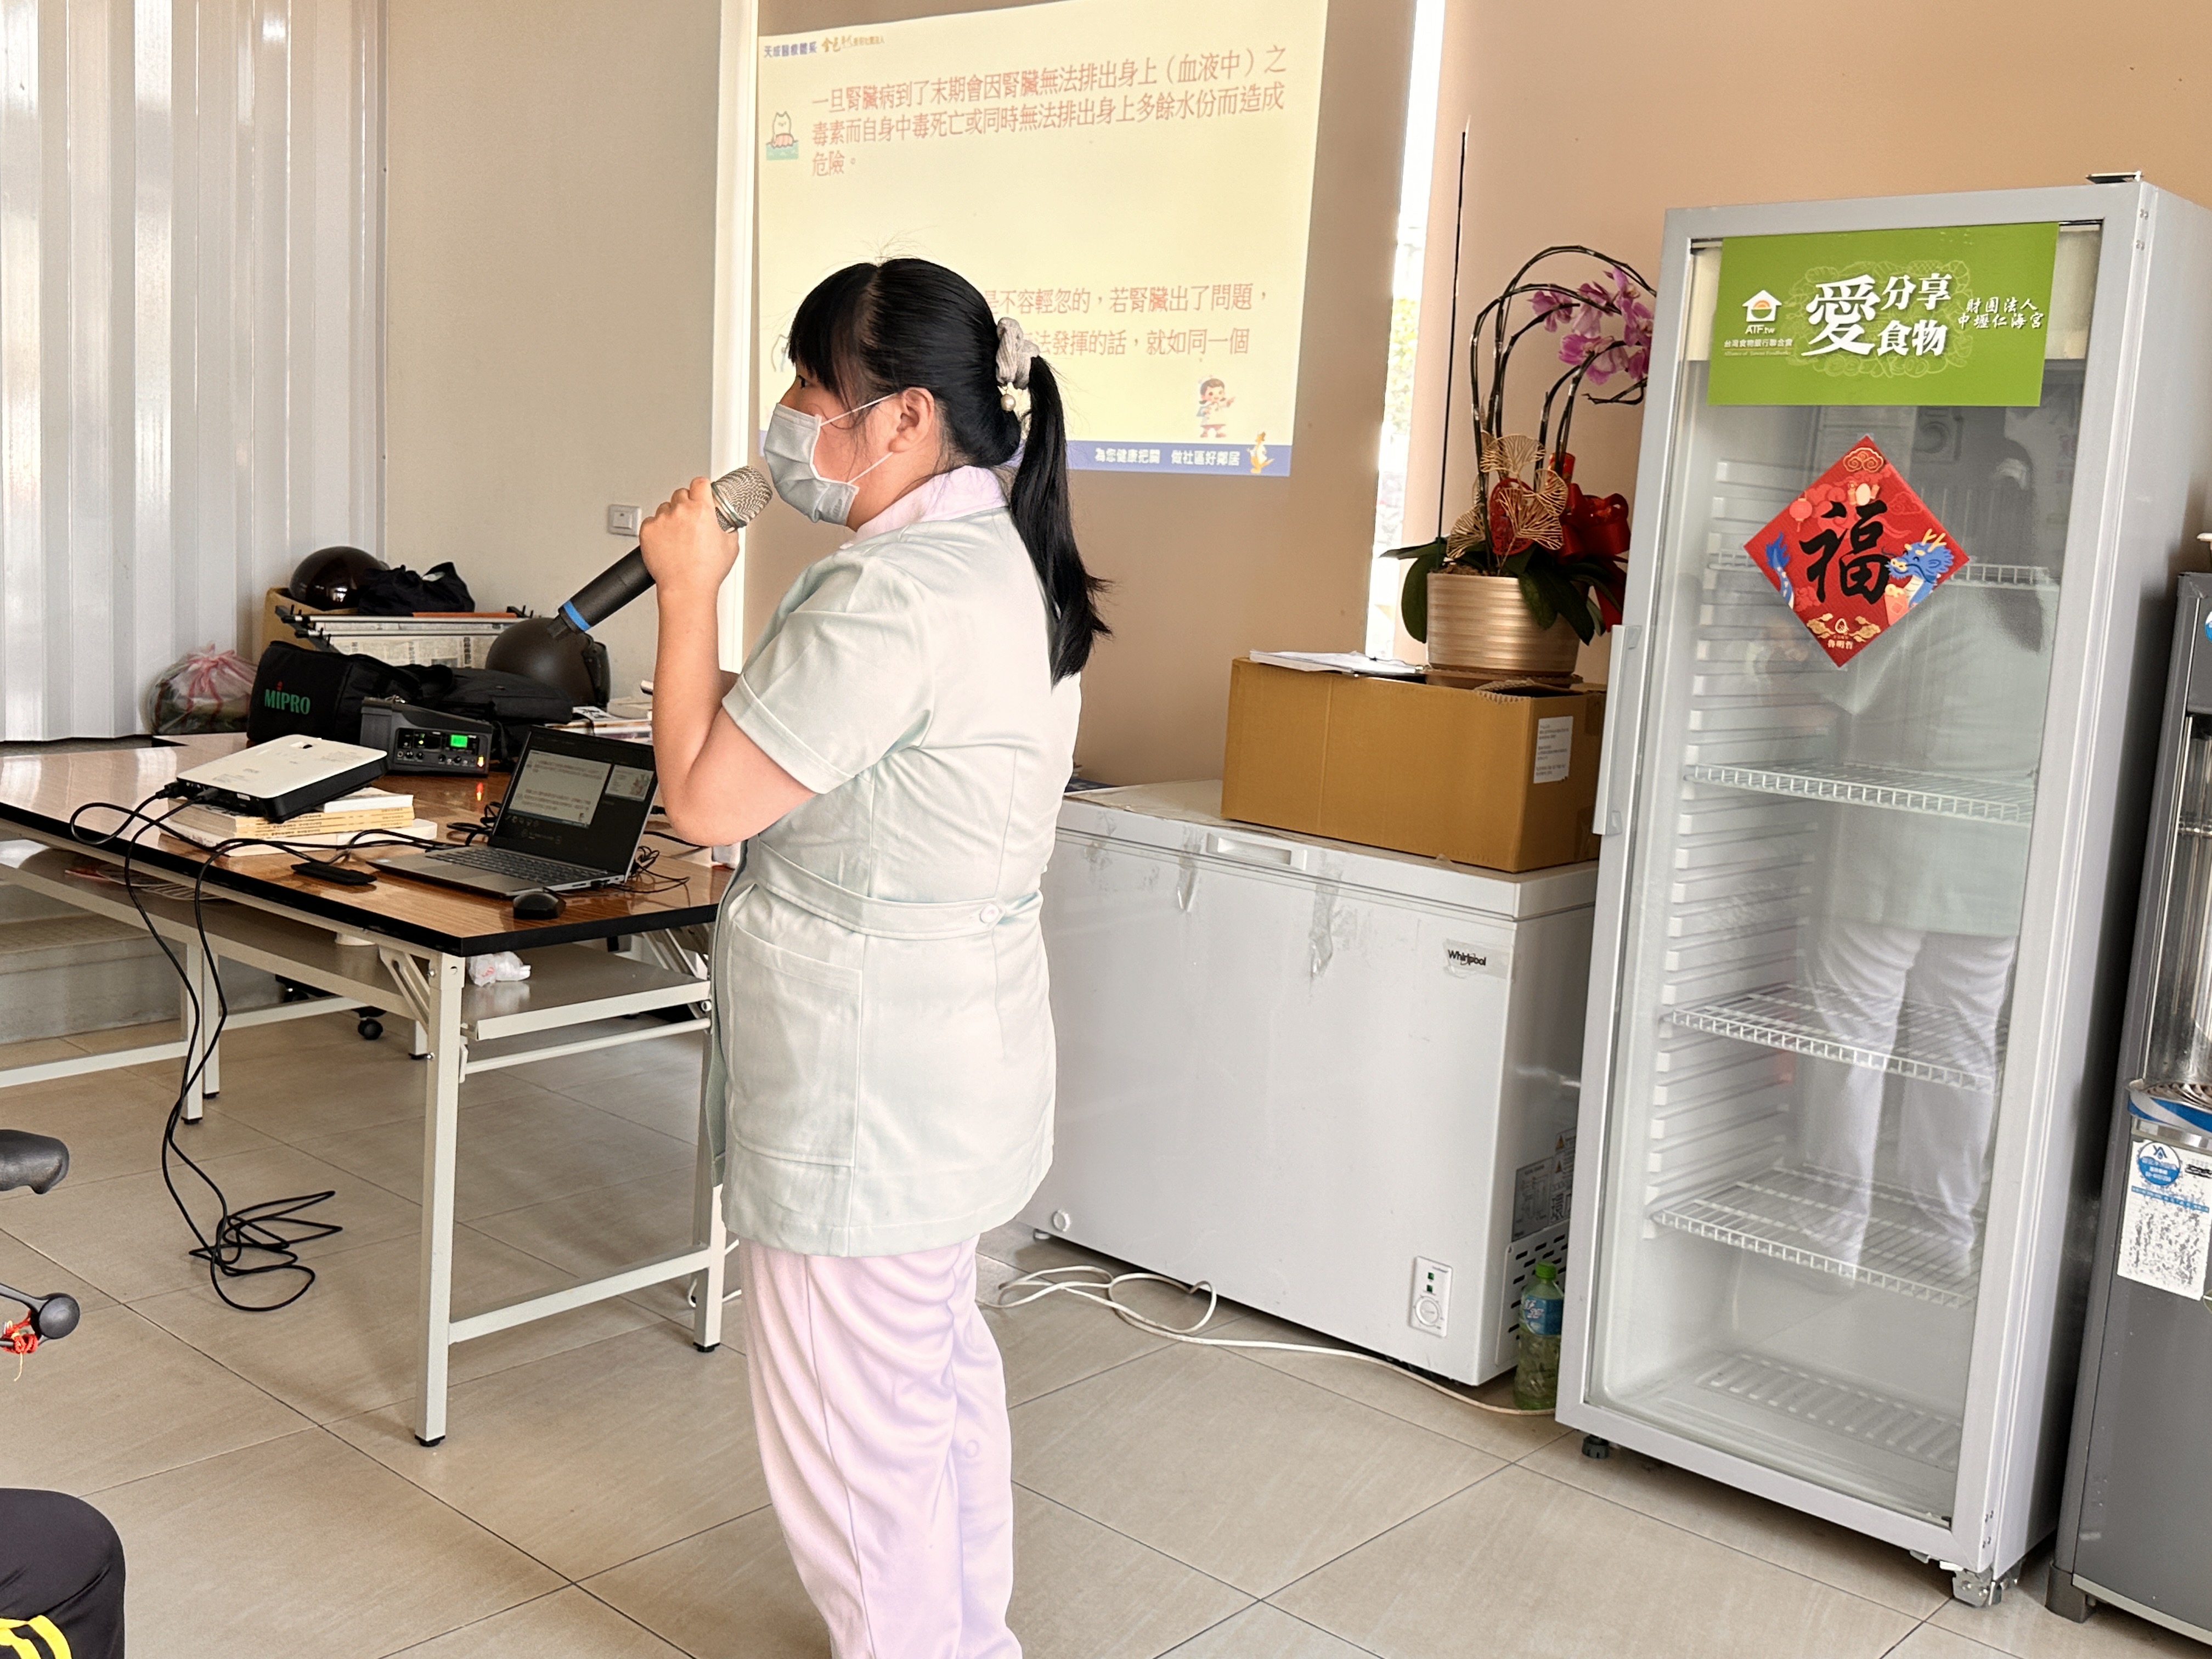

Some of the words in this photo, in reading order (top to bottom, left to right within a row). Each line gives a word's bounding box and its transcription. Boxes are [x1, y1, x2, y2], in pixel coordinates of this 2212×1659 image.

[812, 150, 857, 177] 危險。
[1881, 272, 1954, 311] 分享
[1801, 274, 1881, 356] 愛
[1957, 312, 2045, 330] 中壢仁海宮
[1024, 327, 1250, 356] 法發揮的話，就如同一個
[1877, 319, 1948, 356] 食物
[1798, 500, 1891, 605] 福
[264, 681, 311, 715] MIPRO
